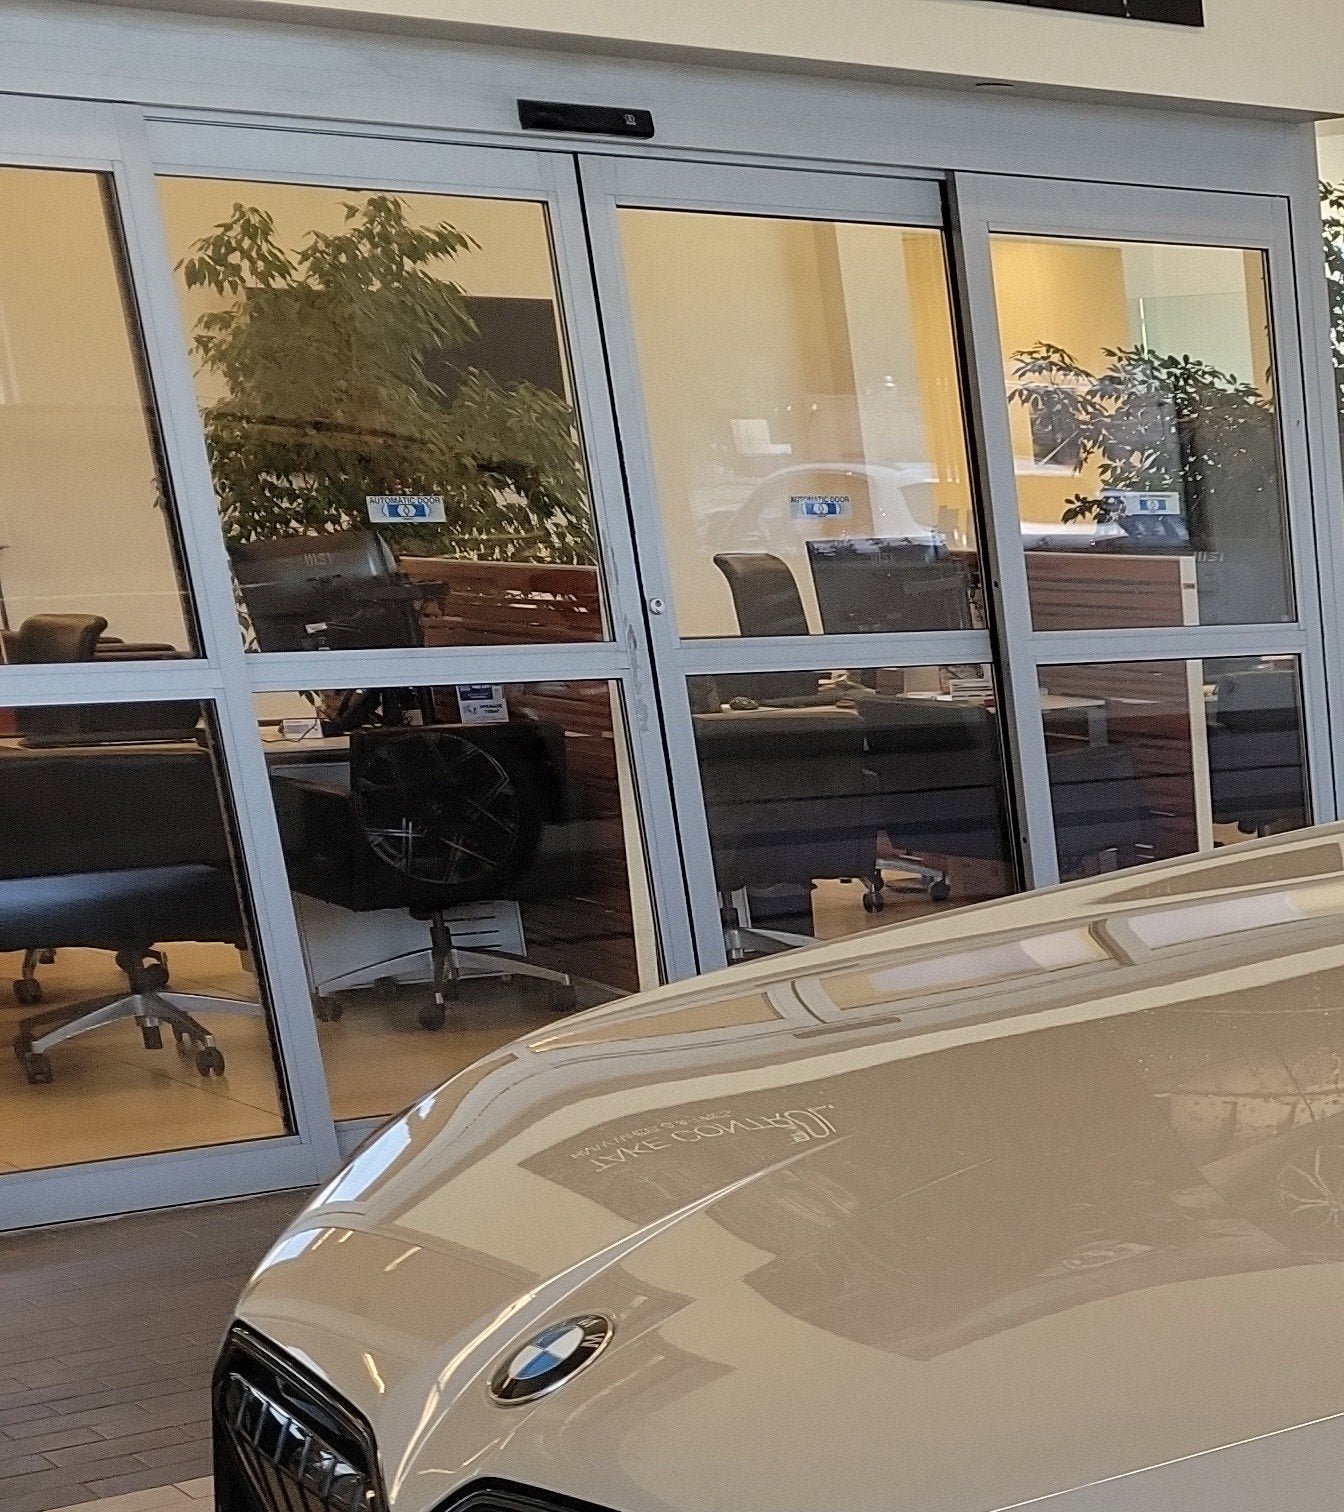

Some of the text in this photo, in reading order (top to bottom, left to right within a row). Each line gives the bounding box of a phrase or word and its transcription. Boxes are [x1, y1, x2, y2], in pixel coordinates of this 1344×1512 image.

[369, 496, 441, 505] AUTOMATIC DOOR
[829, 495, 850, 503] DOOR
